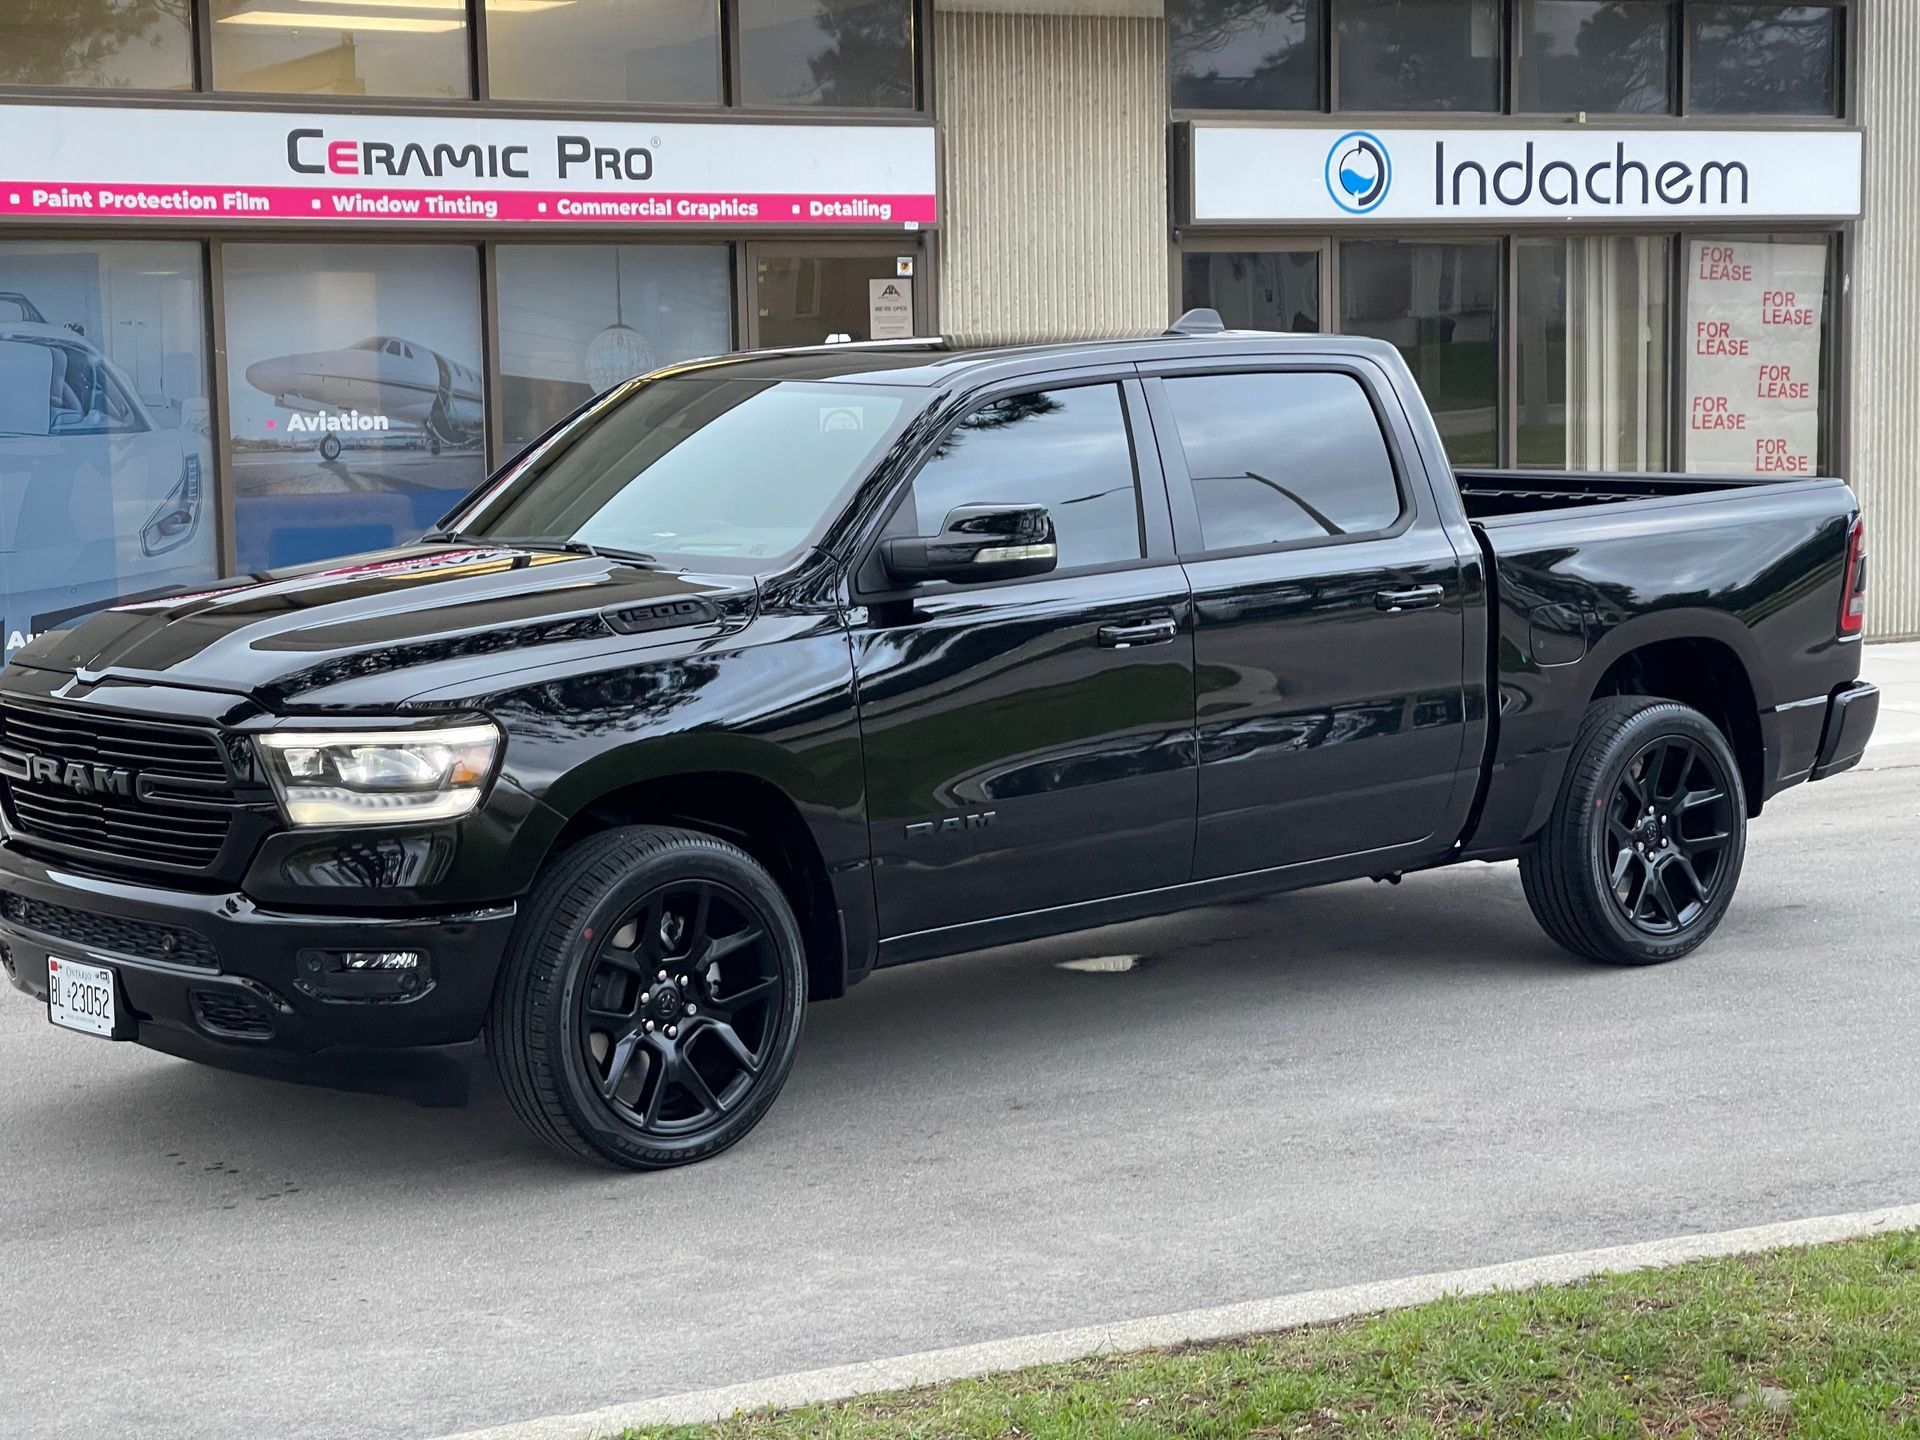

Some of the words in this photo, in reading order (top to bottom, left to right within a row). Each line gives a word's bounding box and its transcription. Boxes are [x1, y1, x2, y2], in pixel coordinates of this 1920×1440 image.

[1434, 140, 1749, 207] Indachem
[32, 188, 92, 209] Paint
[99, 189, 217, 211] Protection
[223, 190, 270, 211] Film
[332, 192, 420, 215] Window
[425, 195, 498, 219] Tinting
[556, 198, 672, 217] Commercial
[676, 197, 759, 220] Graphics
[809, 199, 892, 221] Detailing
[1700, 246, 1734, 264] FOR
[1699, 264, 1752, 281] LEASE
[1763, 291, 1796, 307] FOR
[1762, 308, 1813, 325] LEASE
[1697, 322, 1730, 338] FOR
[1696, 339, 1749, 356] LEASE
[1759, 365, 1791, 381] FOR
[1757, 382, 1809, 399] LEASE
[1693, 396, 1728, 412] FOR
[286, 409, 389, 433] Aviation
[1692, 414, 1746, 430] LEASE
[1756, 439, 1787, 454] FOR
[1755, 456, 1808, 472] LEASE
[621, 602, 698, 622] 1500
[32, 754, 130, 797] RAM
[904, 810, 996, 839] RAM
[71, 981, 110, 1020] 23052
